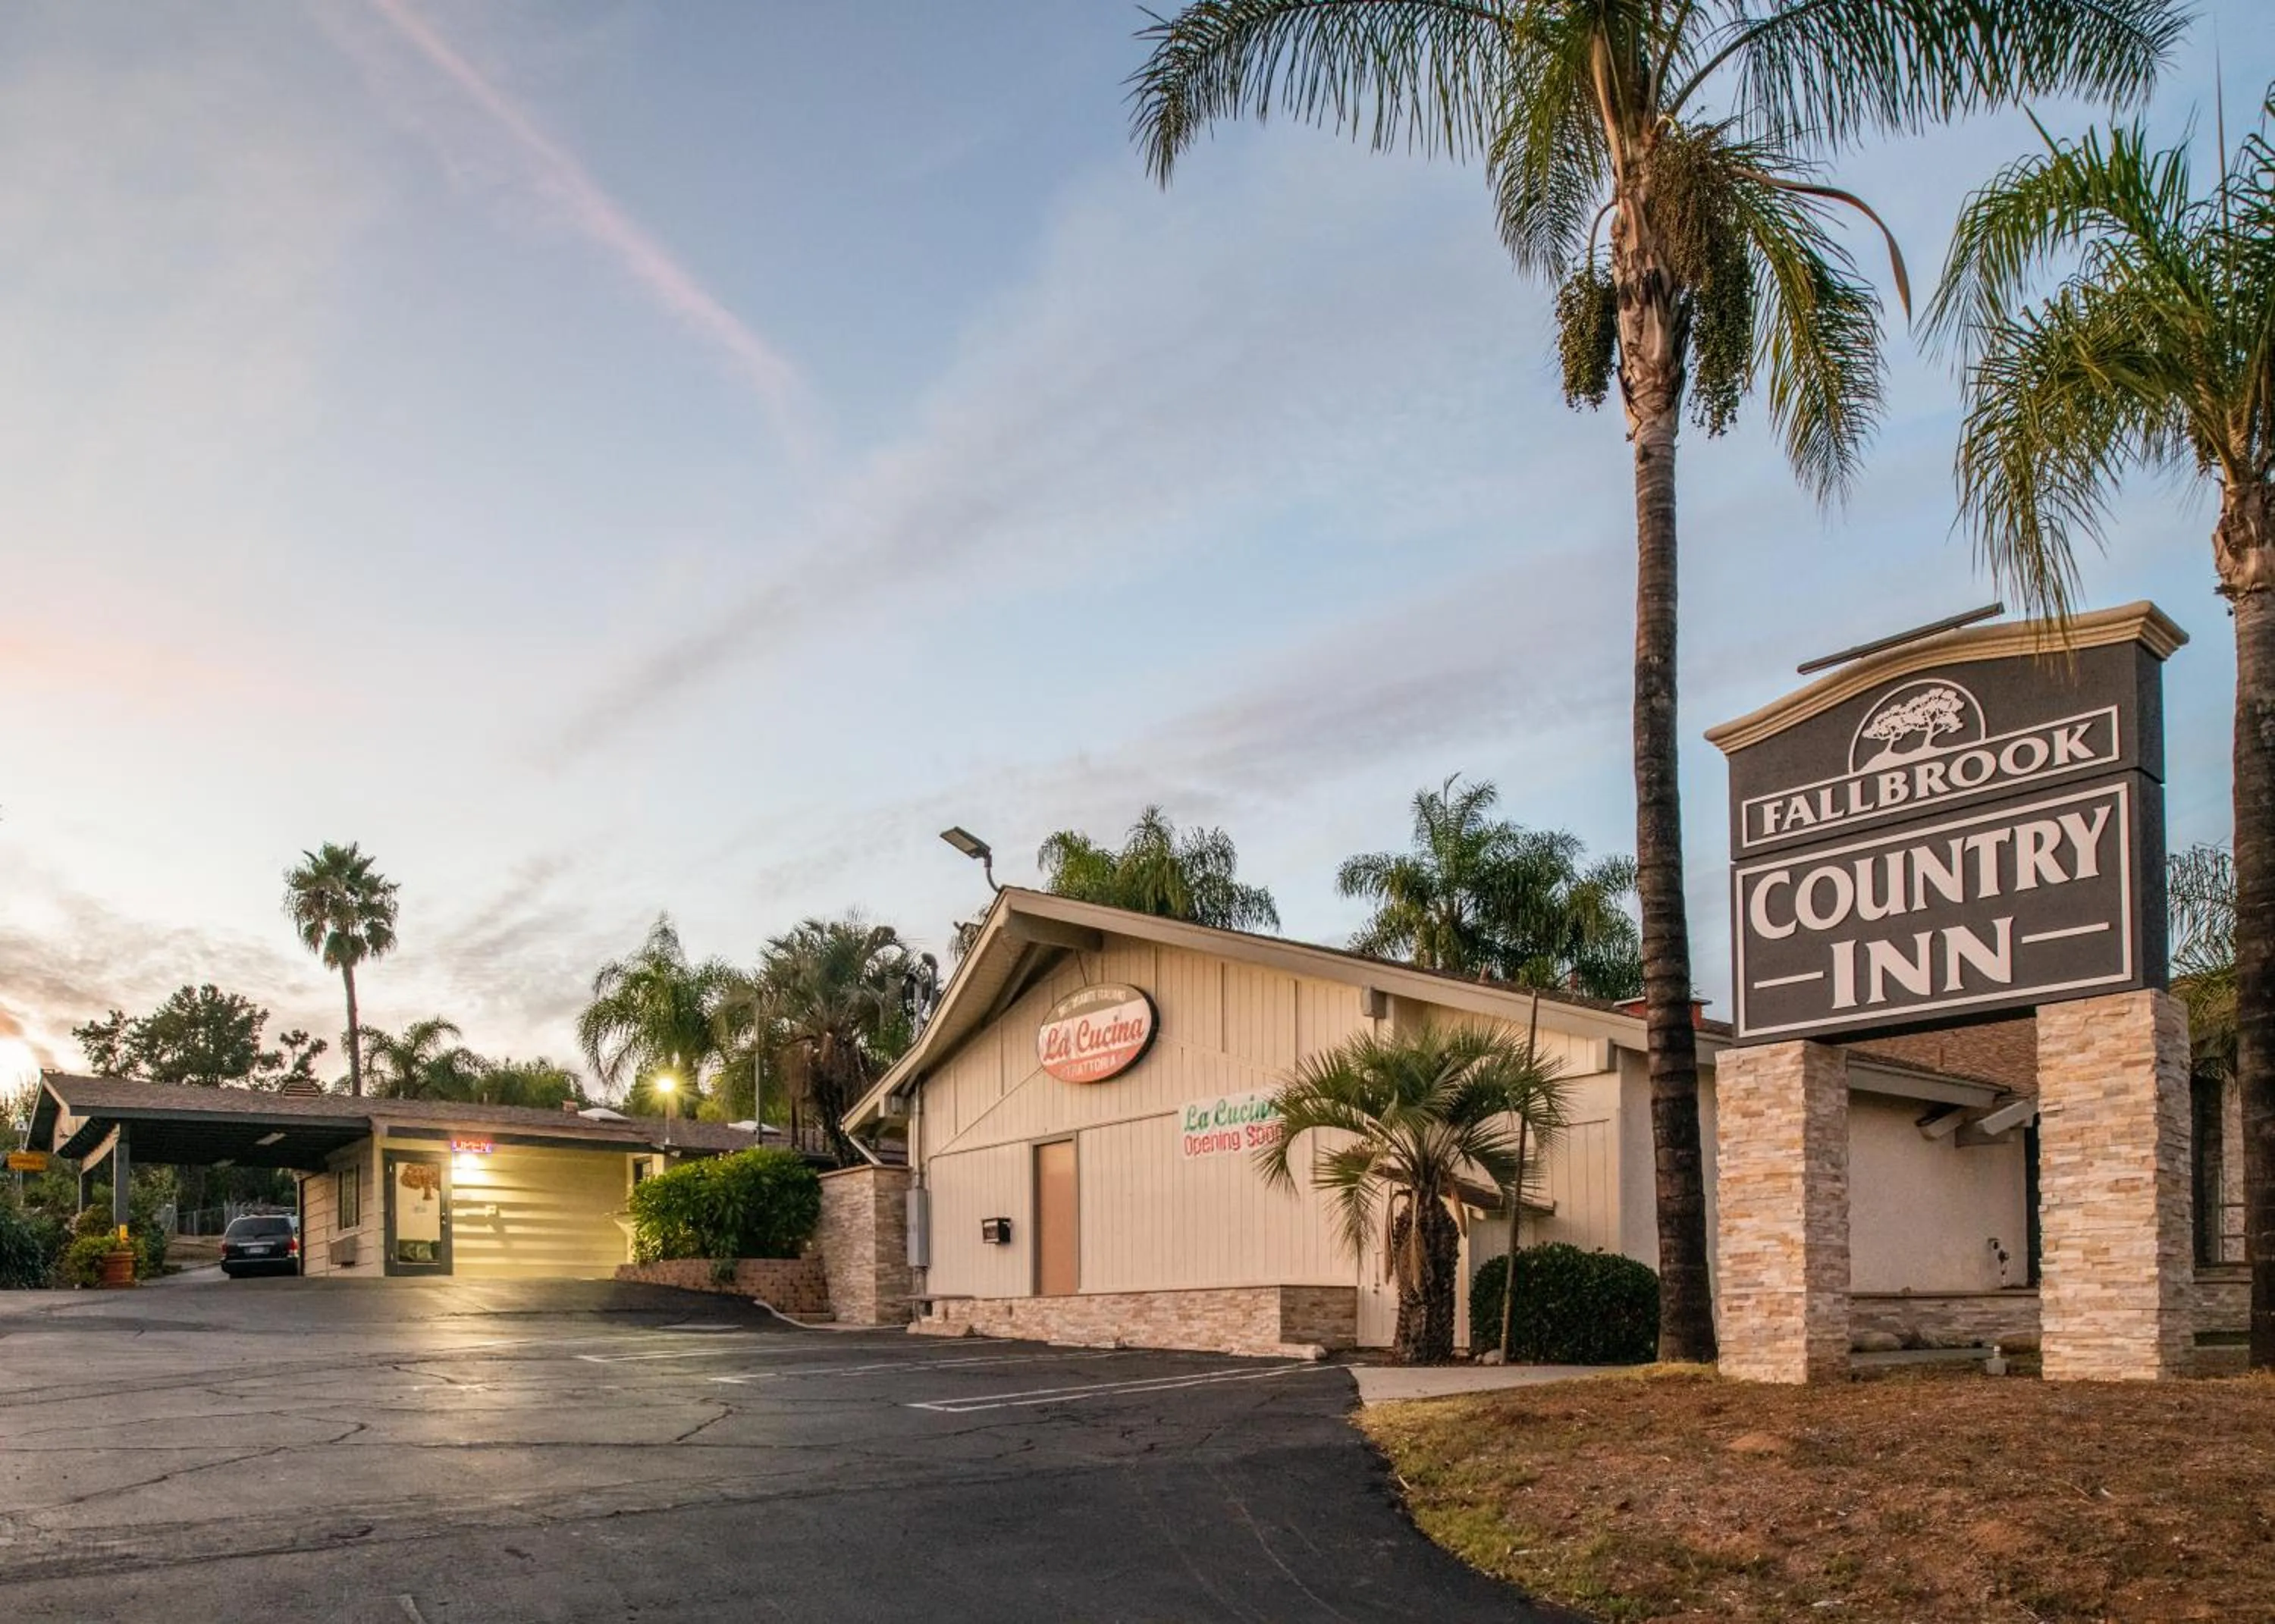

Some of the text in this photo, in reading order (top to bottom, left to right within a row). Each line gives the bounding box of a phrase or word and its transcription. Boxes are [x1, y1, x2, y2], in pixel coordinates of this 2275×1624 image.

[1762, 723, 2097, 835] FALLBROOK
[1749, 805, 2112, 939] COUNTRY
[1831, 916, 2014, 1009] INN
[1043, 1015, 1144, 1061] La Cucina
[1184, 1105, 1209, 1131] La
[1185, 1124, 1285, 1156] Opening Soon
